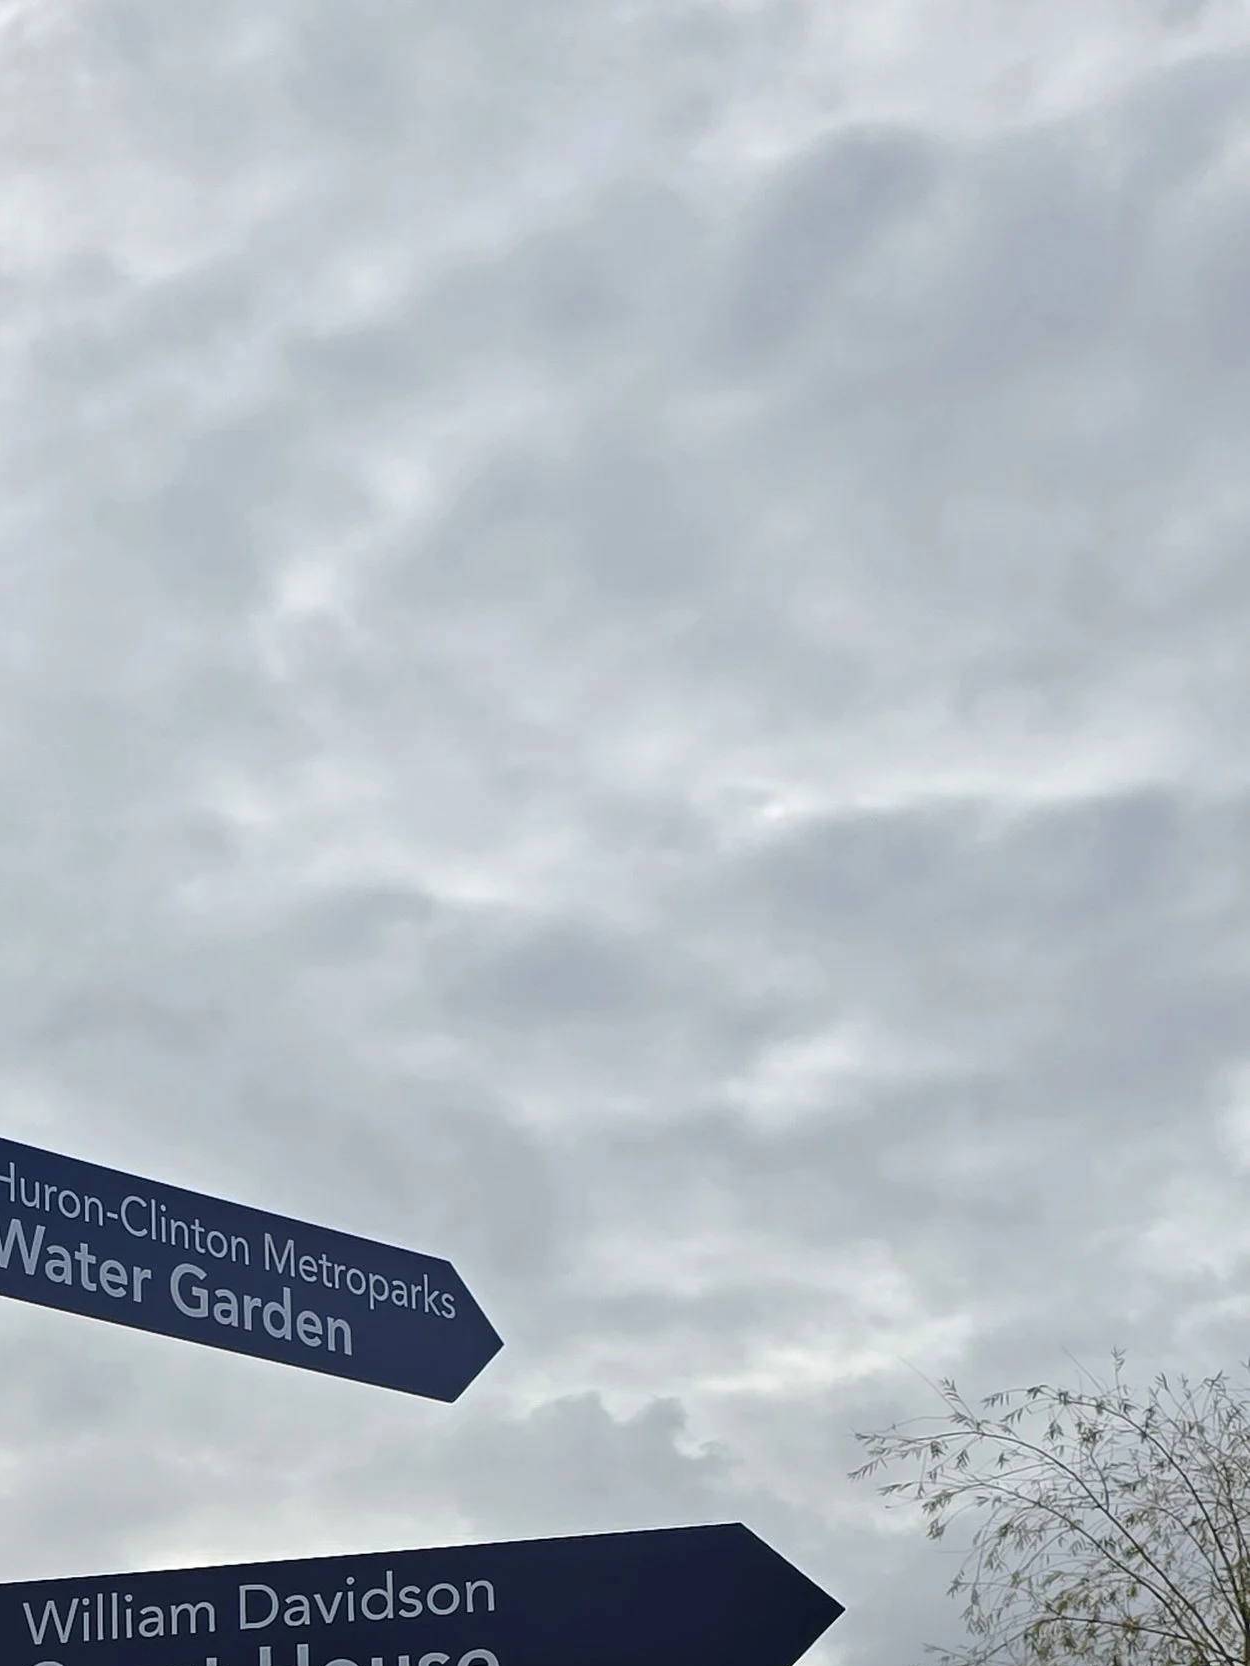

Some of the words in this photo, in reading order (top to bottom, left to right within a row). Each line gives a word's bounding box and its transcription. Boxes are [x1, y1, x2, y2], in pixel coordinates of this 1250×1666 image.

[170, 1262, 354, 1357] Garden
[264, 1232, 457, 1320] Metroparks
[22, 1592, 216, 1645] William
[239, 1570, 496, 1630] Davidson
